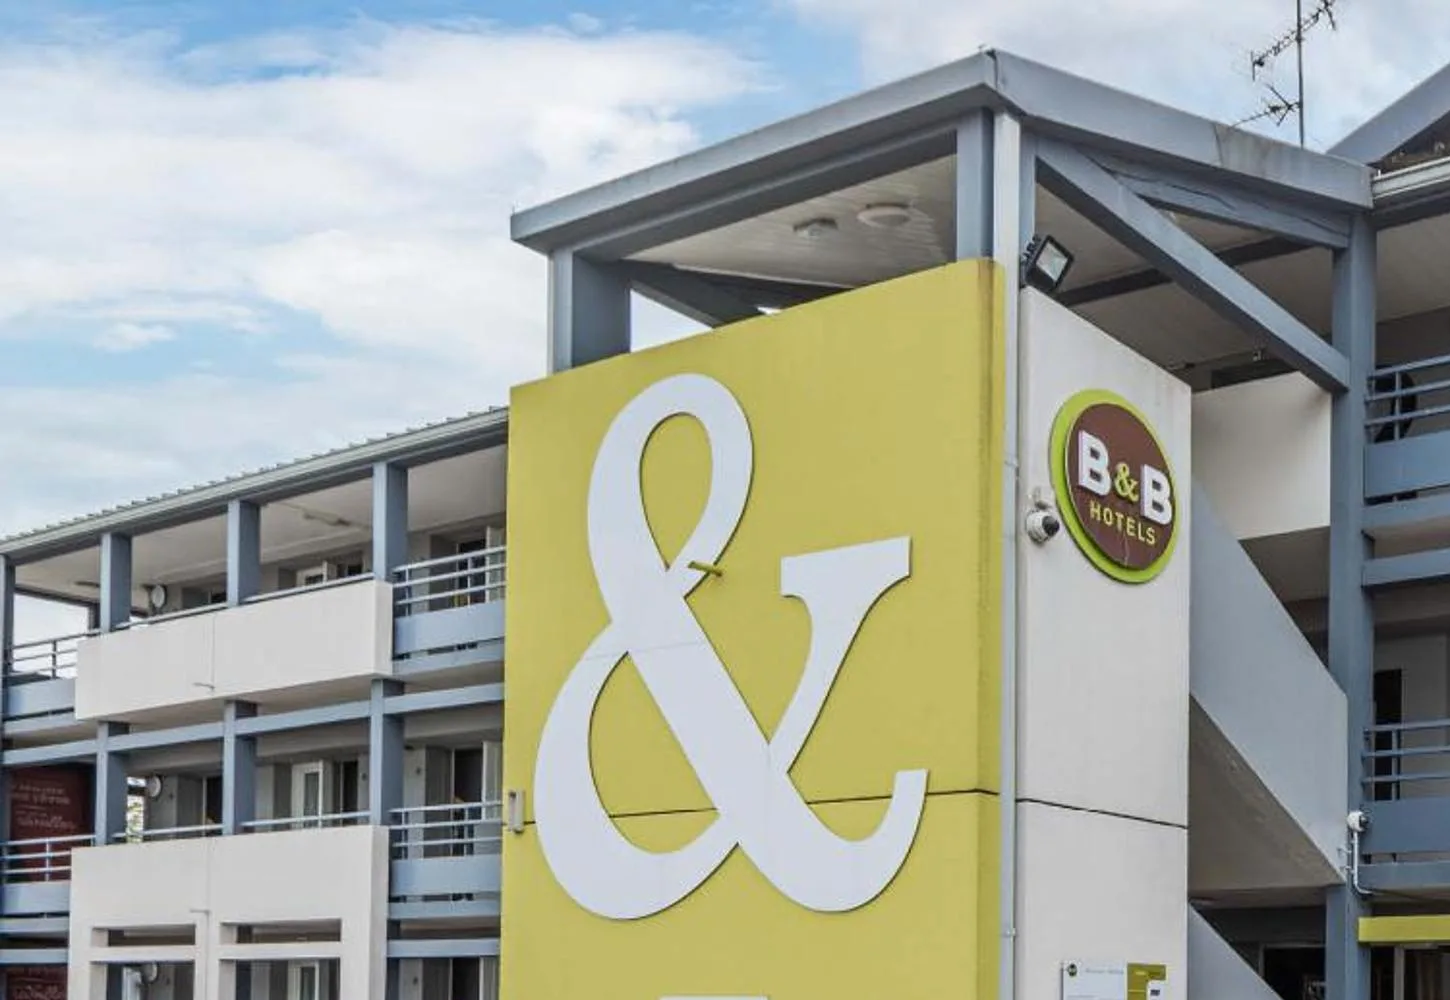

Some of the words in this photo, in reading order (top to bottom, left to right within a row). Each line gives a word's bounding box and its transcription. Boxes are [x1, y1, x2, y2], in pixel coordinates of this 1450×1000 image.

[1078, 430, 1173, 526] B&B
[1089, 499, 1157, 546] HOTELS
[533, 372, 930, 921] &
